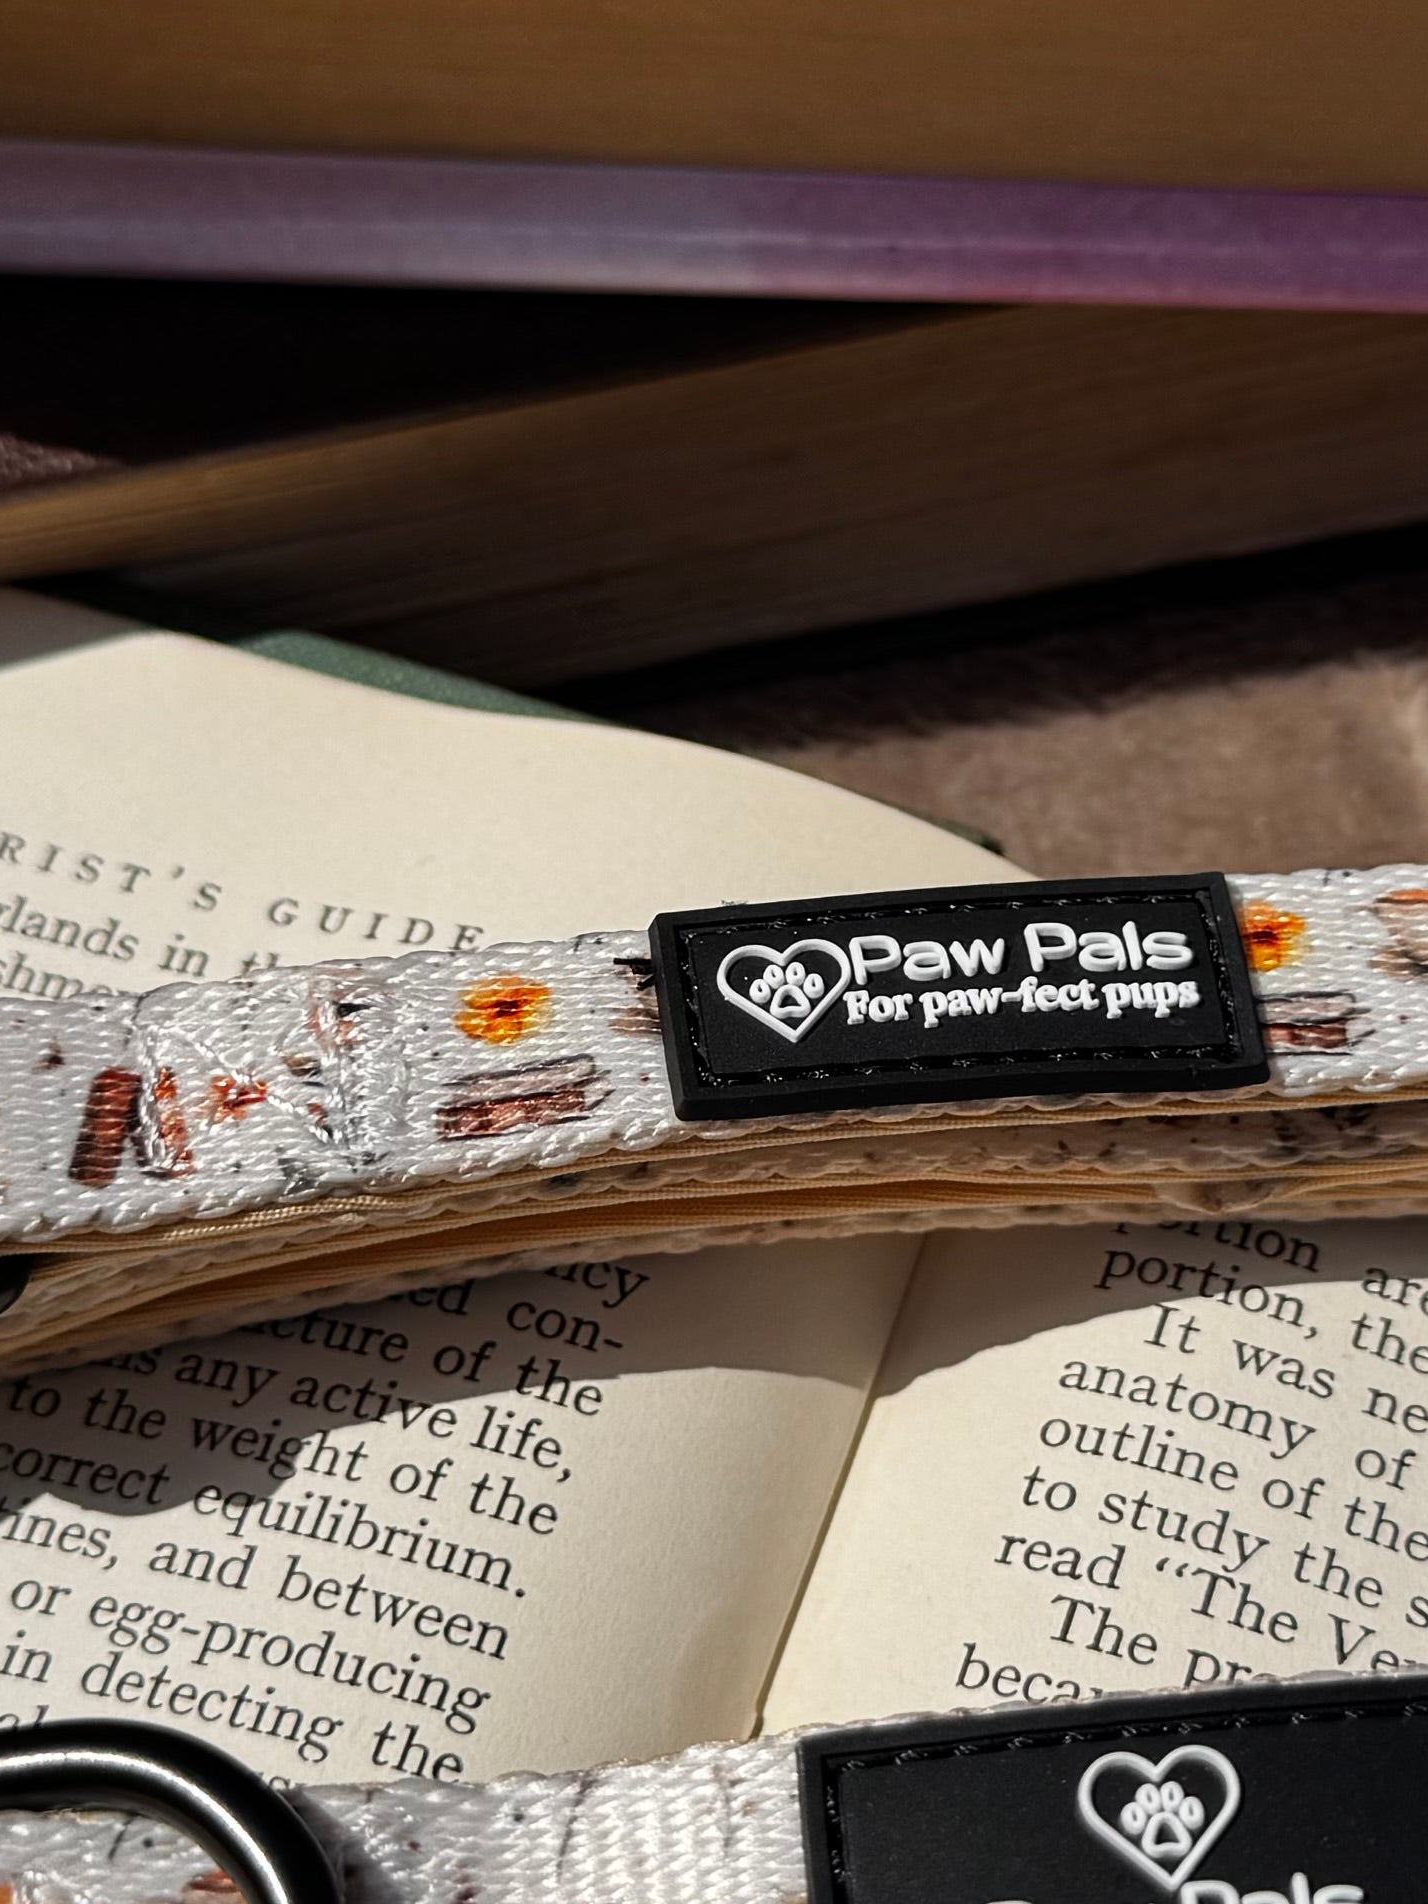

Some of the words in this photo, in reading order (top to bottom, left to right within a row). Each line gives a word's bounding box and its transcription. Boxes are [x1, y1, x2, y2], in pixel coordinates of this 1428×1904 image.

[266, 897, 486, 954] GUIDE
[849, 934, 1005, 985] Paw
[1024, 921, 1195, 972] Pals
[843, 989, 913, 1027] For
[918, 976, 1099, 1029] paw-fect
[1102, 979, 1201, 1019] pups
[1233, 1340, 1335, 1399] was
[469, 1405, 571, 1483] life,
[1059, 1361, 1316, 1460] anatomy
[1355, 1449, 1417, 1491] of
[390, 1458, 454, 1502] of
[470, 1473, 558, 1535] the
[193, 1480, 529, 1600] equilibrium.
[148, 1543, 258, 1590] and
[277, 1555, 508, 1660] between
[10, 1580, 72, 1615] or
[89, 1597, 491, 1735] egg-producing
[81, 1651, 344, 1764] detecting
